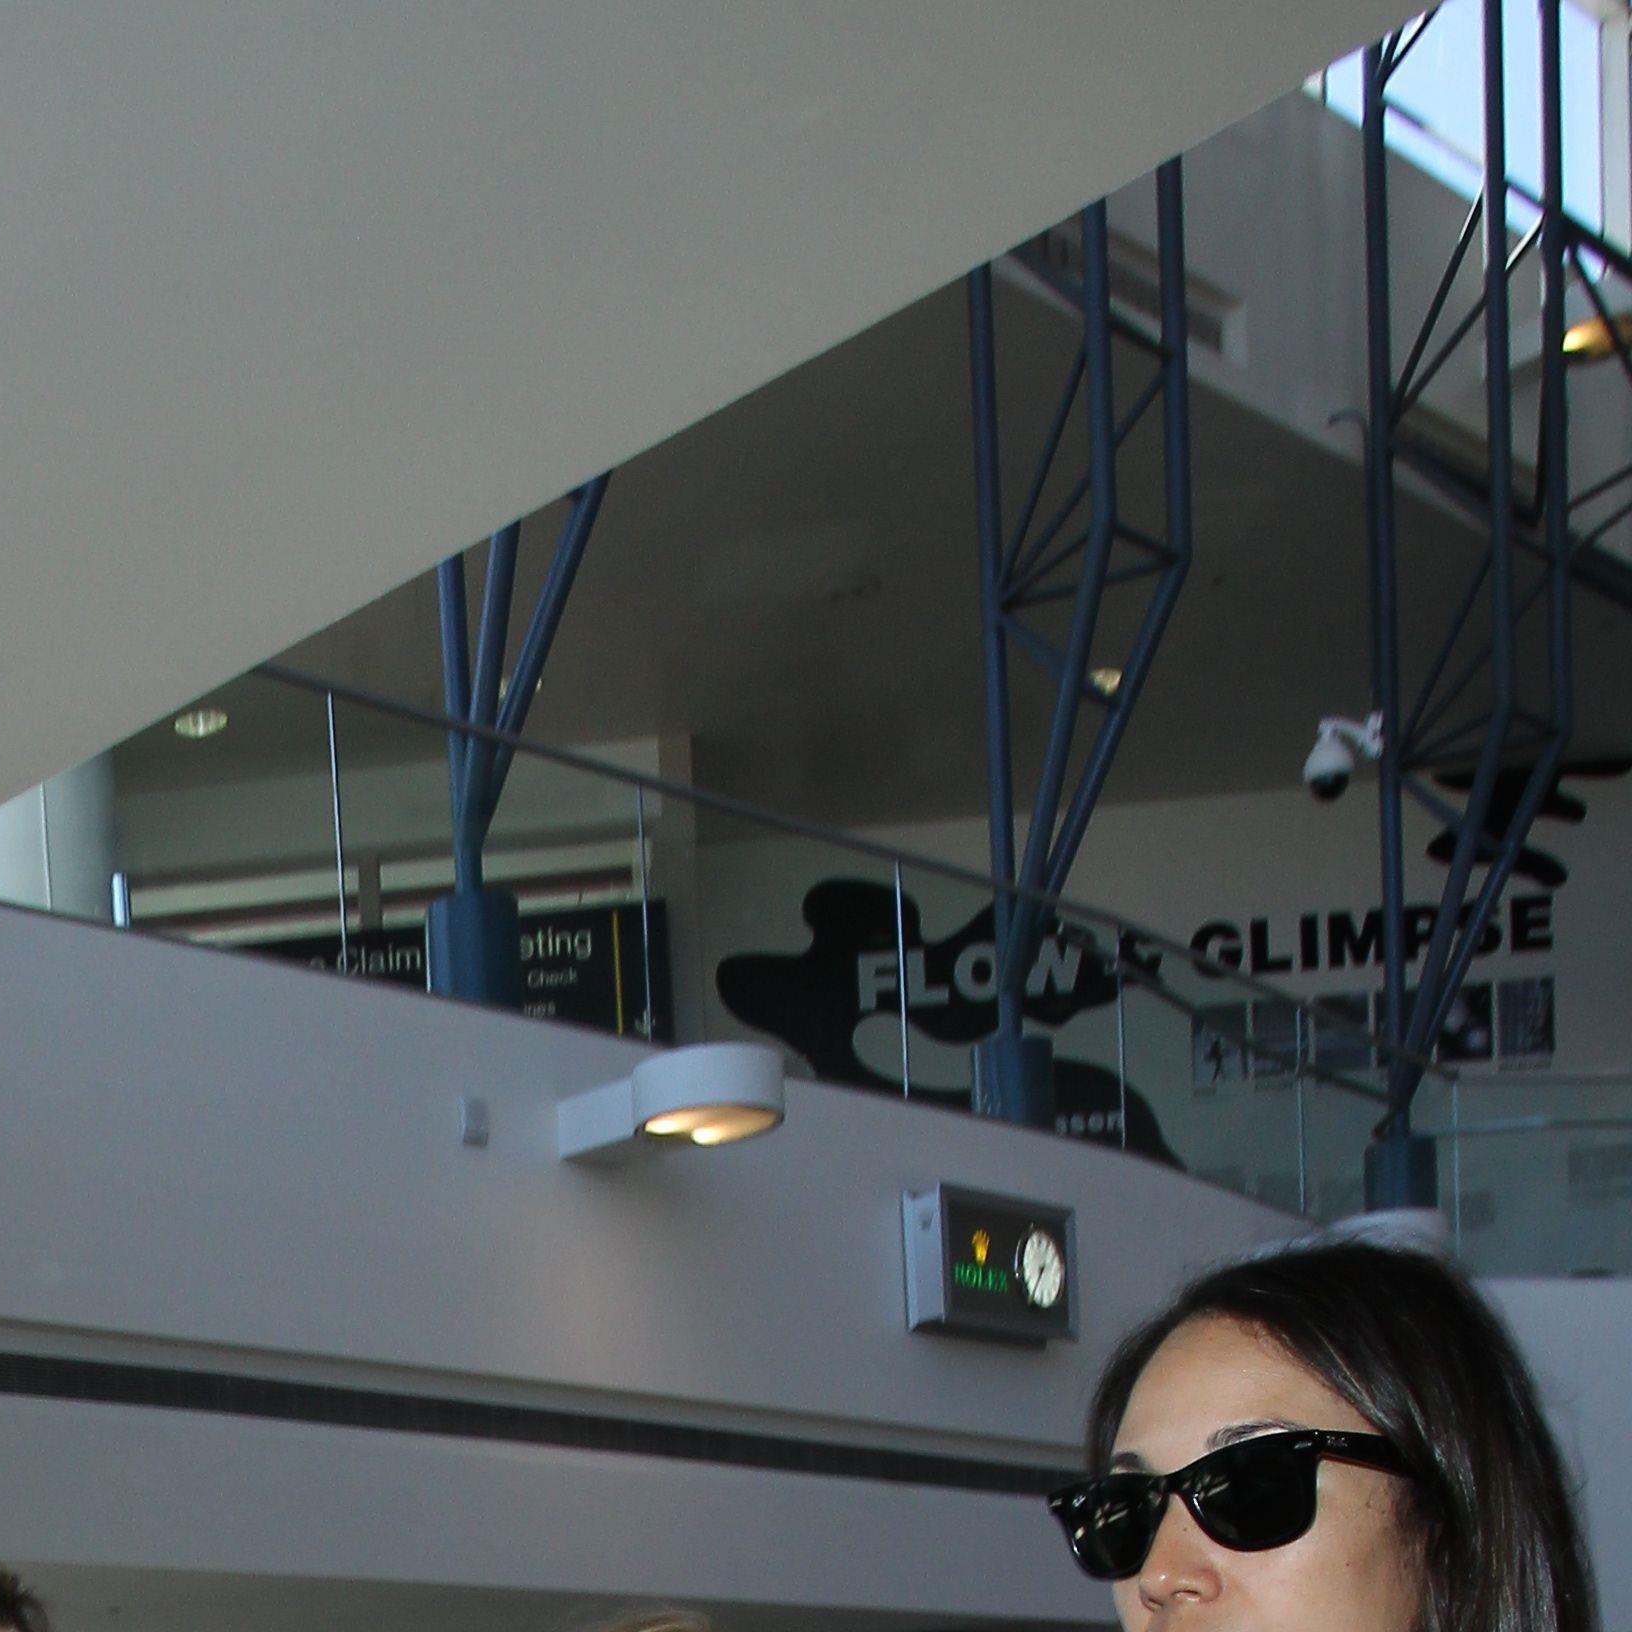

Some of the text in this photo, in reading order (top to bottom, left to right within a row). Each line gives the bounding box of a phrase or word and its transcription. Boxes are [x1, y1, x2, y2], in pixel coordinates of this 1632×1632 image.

[1189, 893, 1553, 980] GLIMPSE
[335, 942, 422, 976] Claim
[953, 1260, 1009, 1294] ROLEX
